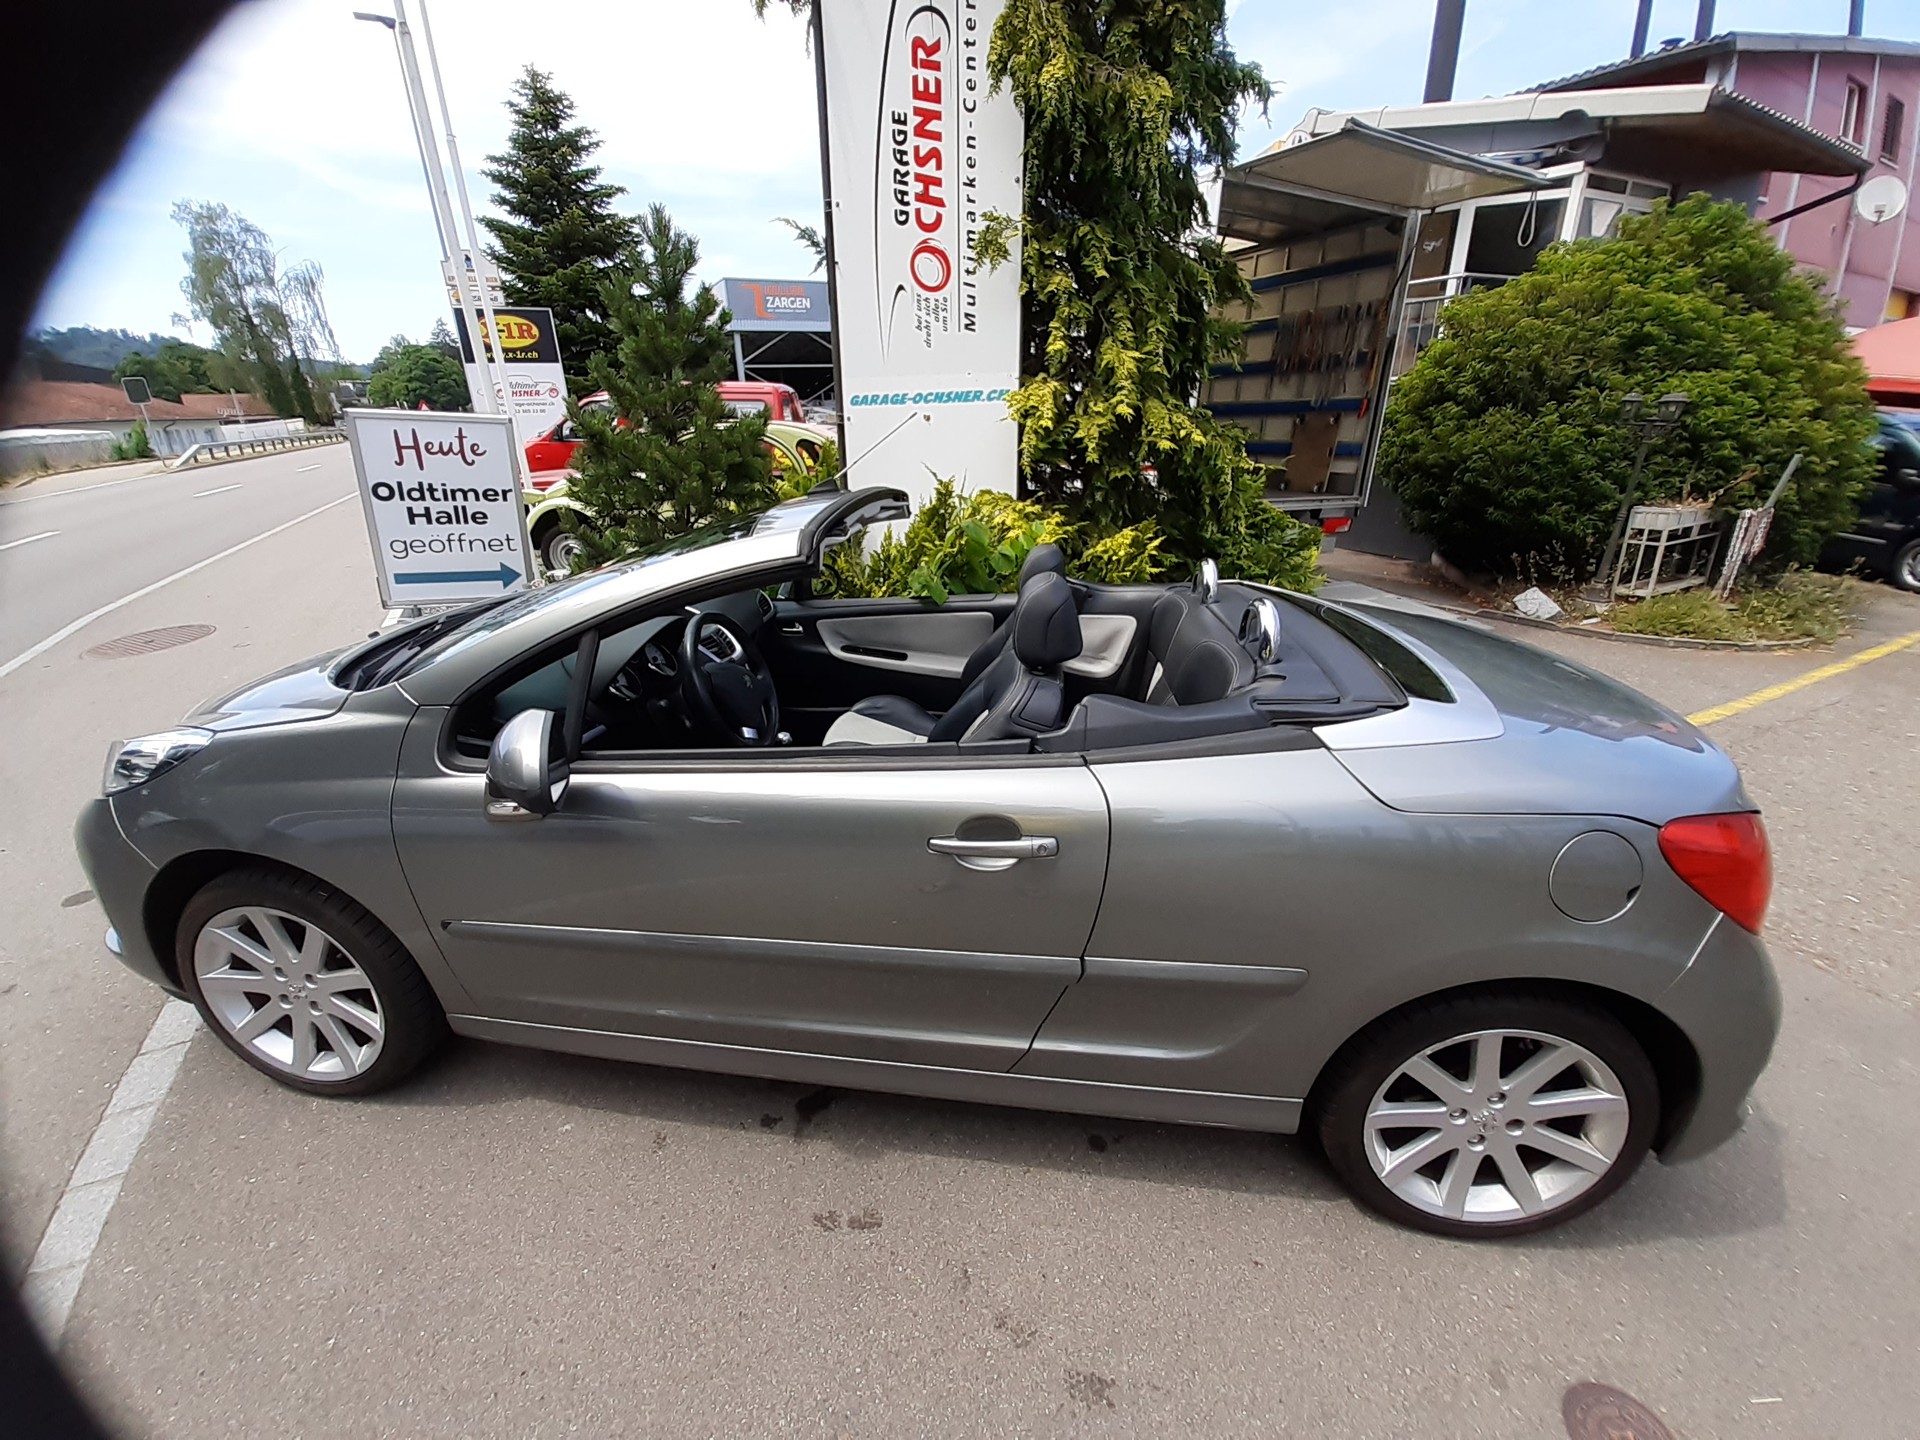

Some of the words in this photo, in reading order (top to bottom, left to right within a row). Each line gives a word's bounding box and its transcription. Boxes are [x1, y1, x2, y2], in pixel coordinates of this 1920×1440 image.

[891, 110, 910, 226] GARAGE
[962, 0, 977, 333] Multimarken-Center
[765, 296, 811, 309] ZARGEN
[923, 296, 931, 318] sich
[932, 297, 940, 323] alles
[940, 296, 948, 313] Sie
[923, 319, 932, 349] dreht
[942, 314, 948, 332] um
[393, 427, 487, 471] Heute
[371, 481, 513, 503] Oldtimer
[406, 505, 488, 525] Halle
[389, 533, 518, 560] geöffnet
